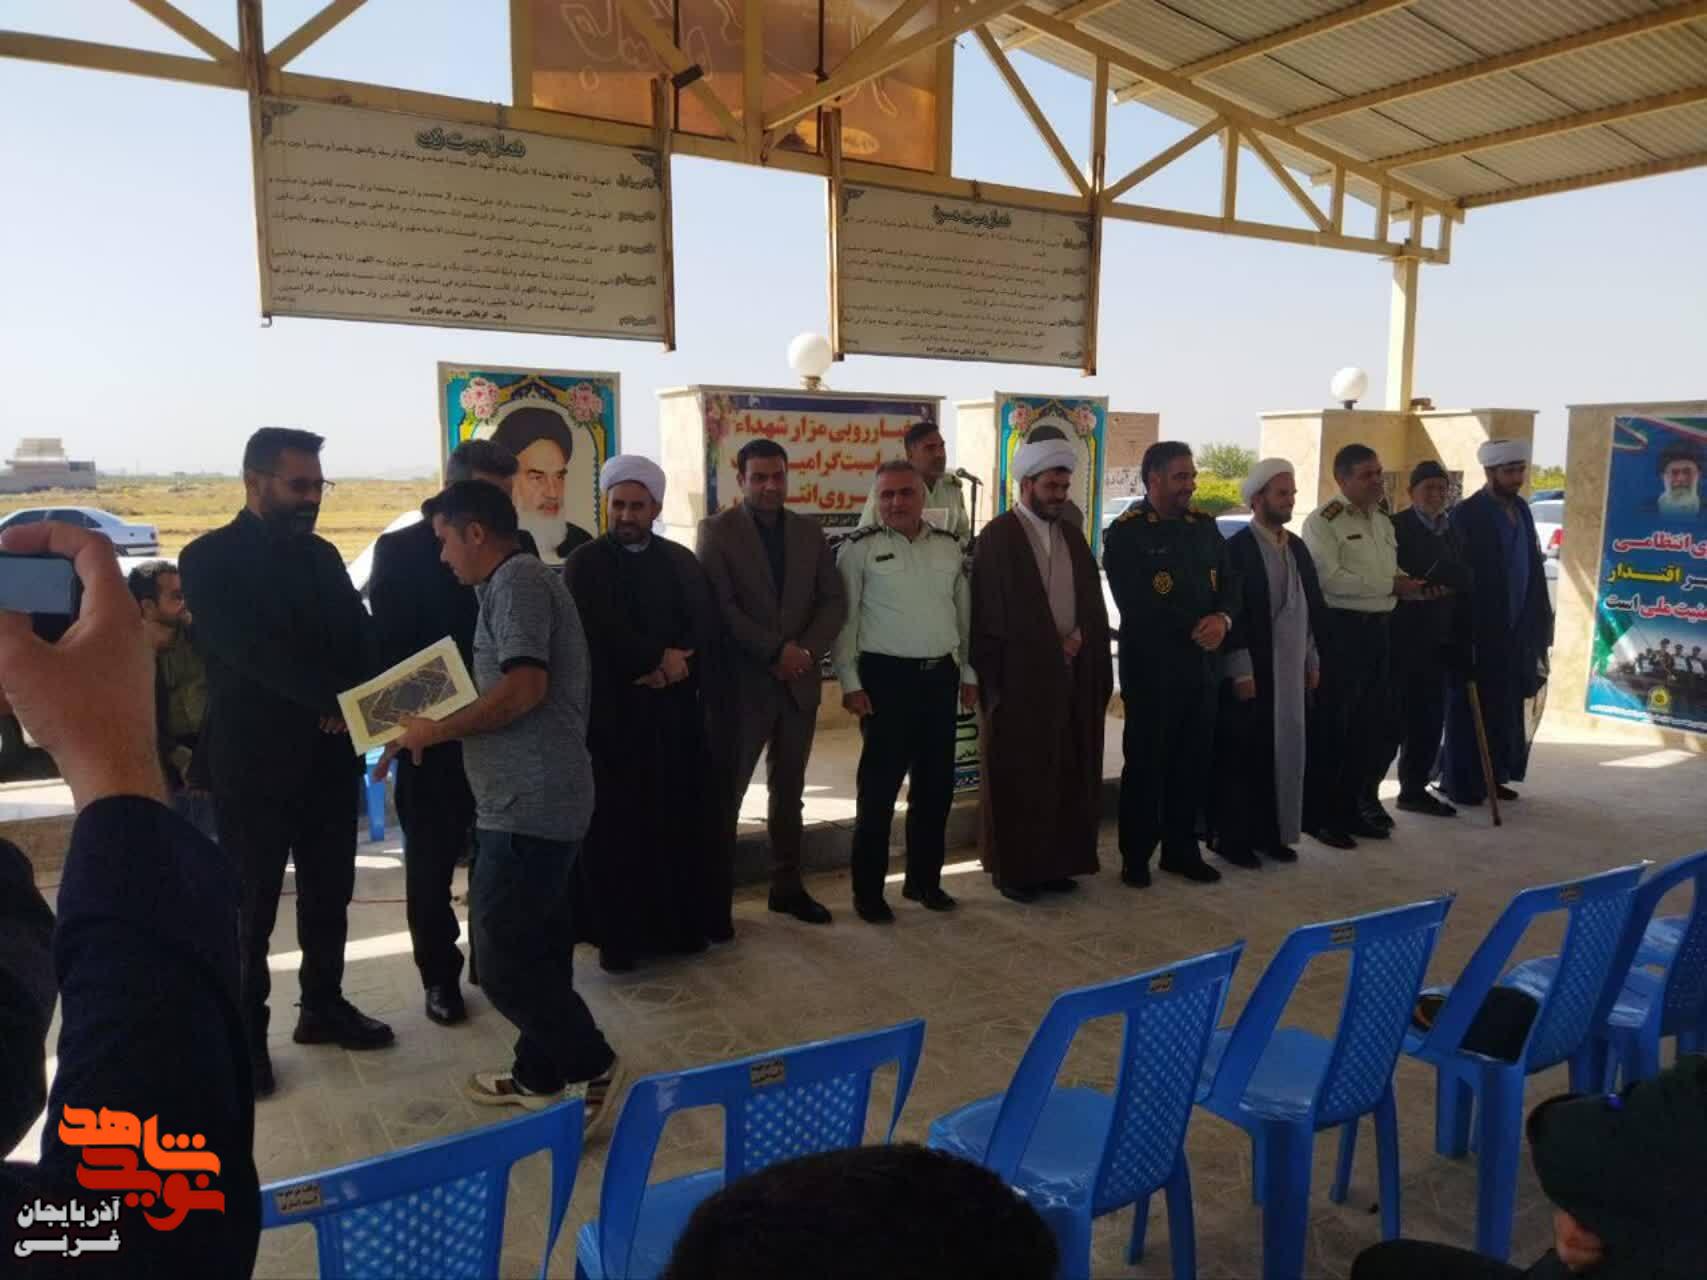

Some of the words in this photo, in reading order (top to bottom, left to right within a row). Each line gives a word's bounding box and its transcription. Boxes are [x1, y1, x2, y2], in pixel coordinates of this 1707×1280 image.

[735, 414, 788, 442] شهداء
[793, 416, 826, 443] مزار
[1612, 531, 1693, 553] انتظامی
[1606, 562, 1683, 585] اقتدار
[1603, 593, 1640, 612] است
[1639, 595, 1673, 618] ملی
